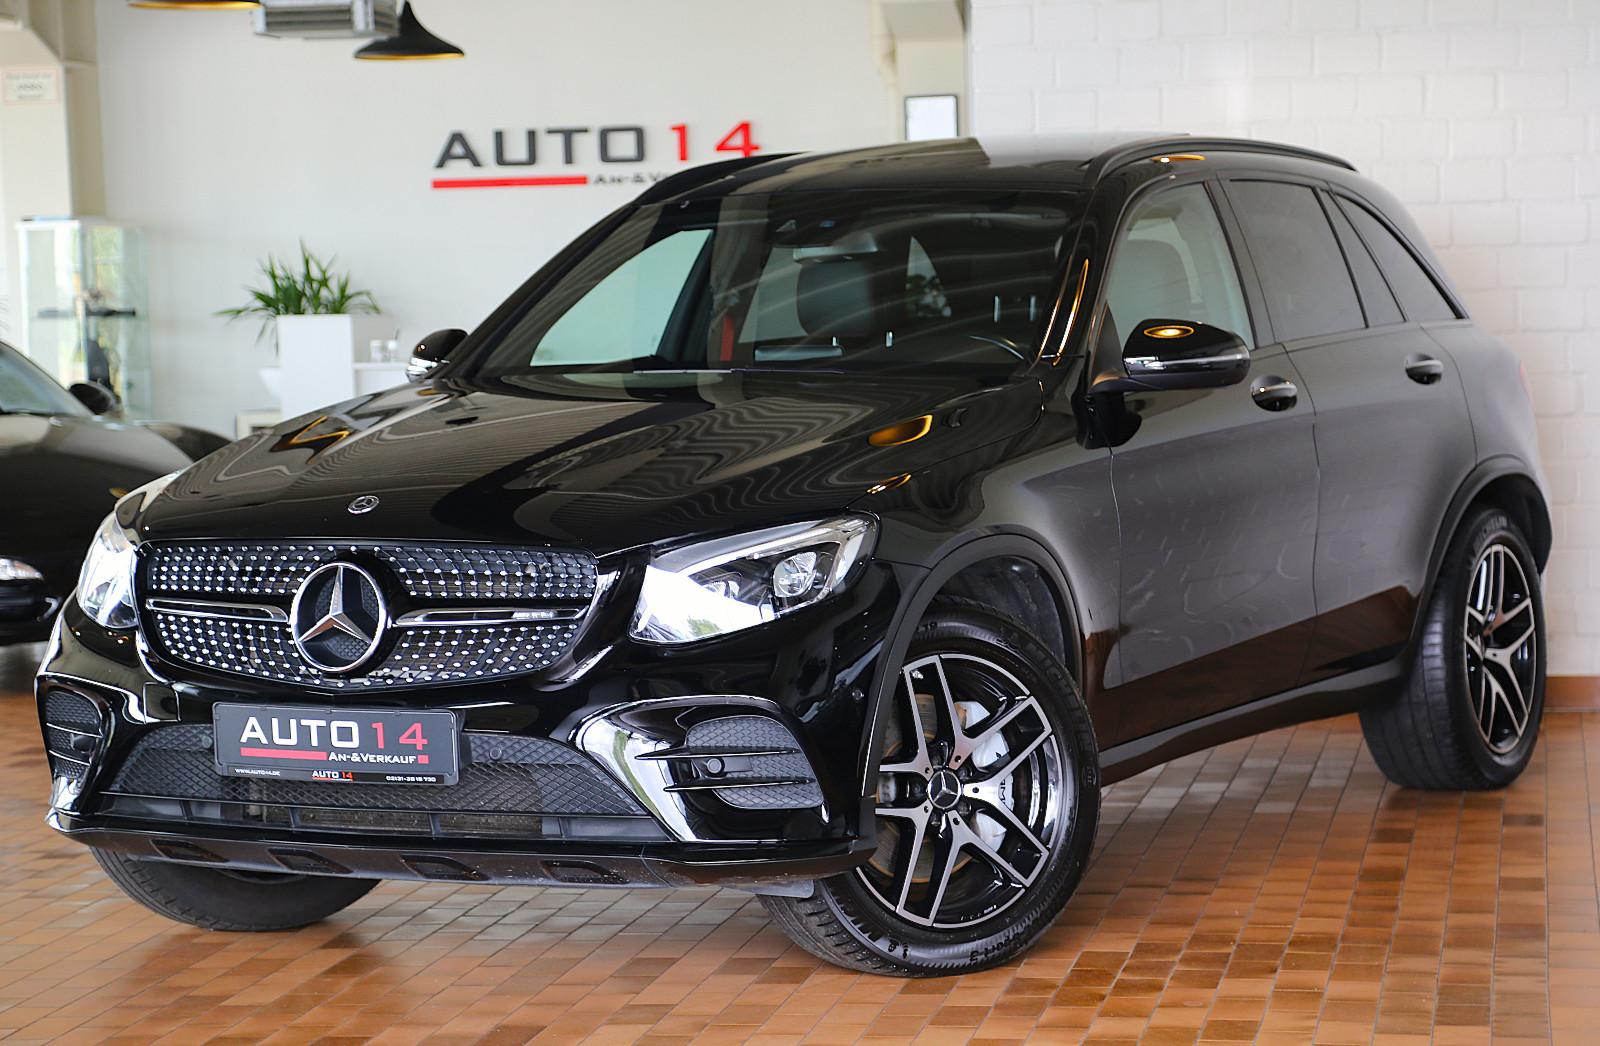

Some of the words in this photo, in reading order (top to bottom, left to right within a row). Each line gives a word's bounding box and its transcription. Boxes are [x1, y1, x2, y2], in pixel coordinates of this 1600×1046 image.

[435, 127, 645, 168] AUTO
[671, 121, 760, 161] 14
[240, 716, 360, 748] AUTO
[372, 722, 429, 750] 14
[312, 770, 339, 778] AUTO
[342, 771, 353, 779] 14
